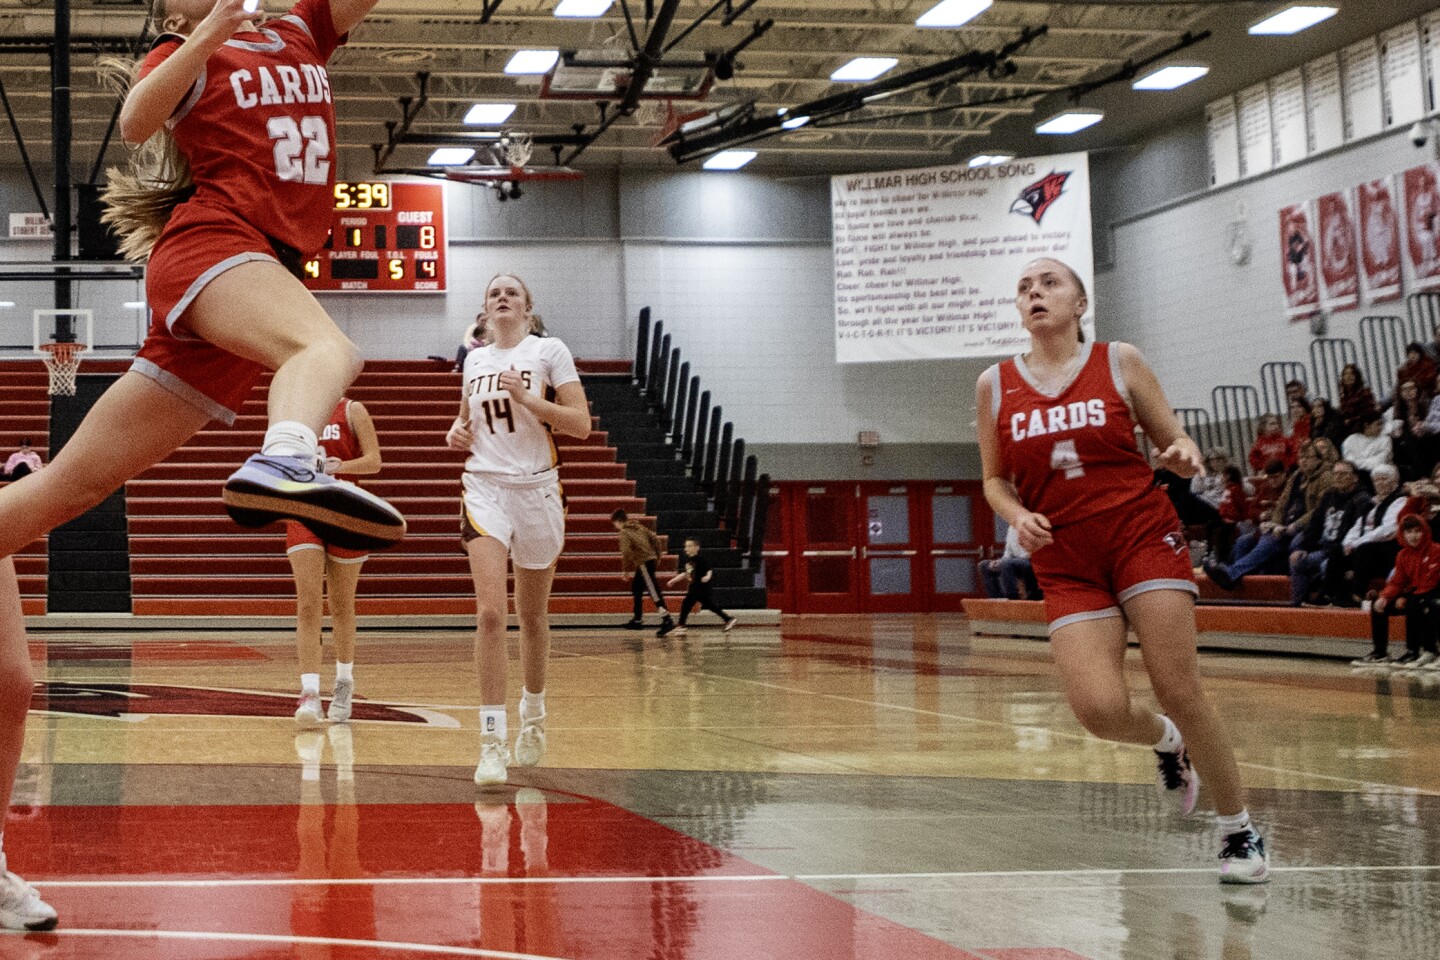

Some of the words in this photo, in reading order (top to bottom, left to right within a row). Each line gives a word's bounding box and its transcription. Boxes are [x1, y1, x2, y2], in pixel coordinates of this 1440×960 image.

[229, 63, 331, 109] CARDS
[266, 115, 330, 185] 22
[906, 172, 937, 186] HIGH
[940, 167, 994, 184] SCHOOL
[998, 162, 1036, 179] SONG
[334, 183, 388, 208] 5:39
[397, 211, 433, 223] GUEST
[420, 226, 435, 249] 8
[305, 260, 320, 278] 4
[389, 259, 404, 280] 5
[423, 261, 435, 277] 4
[905, 277, 939, 287] Willmar
[936, 312, 971, 323] Willmar
[482, 398, 515, 435] 14
[1010, 399, 1107, 442] CARDS
[1050, 439, 1086, 480] 4
